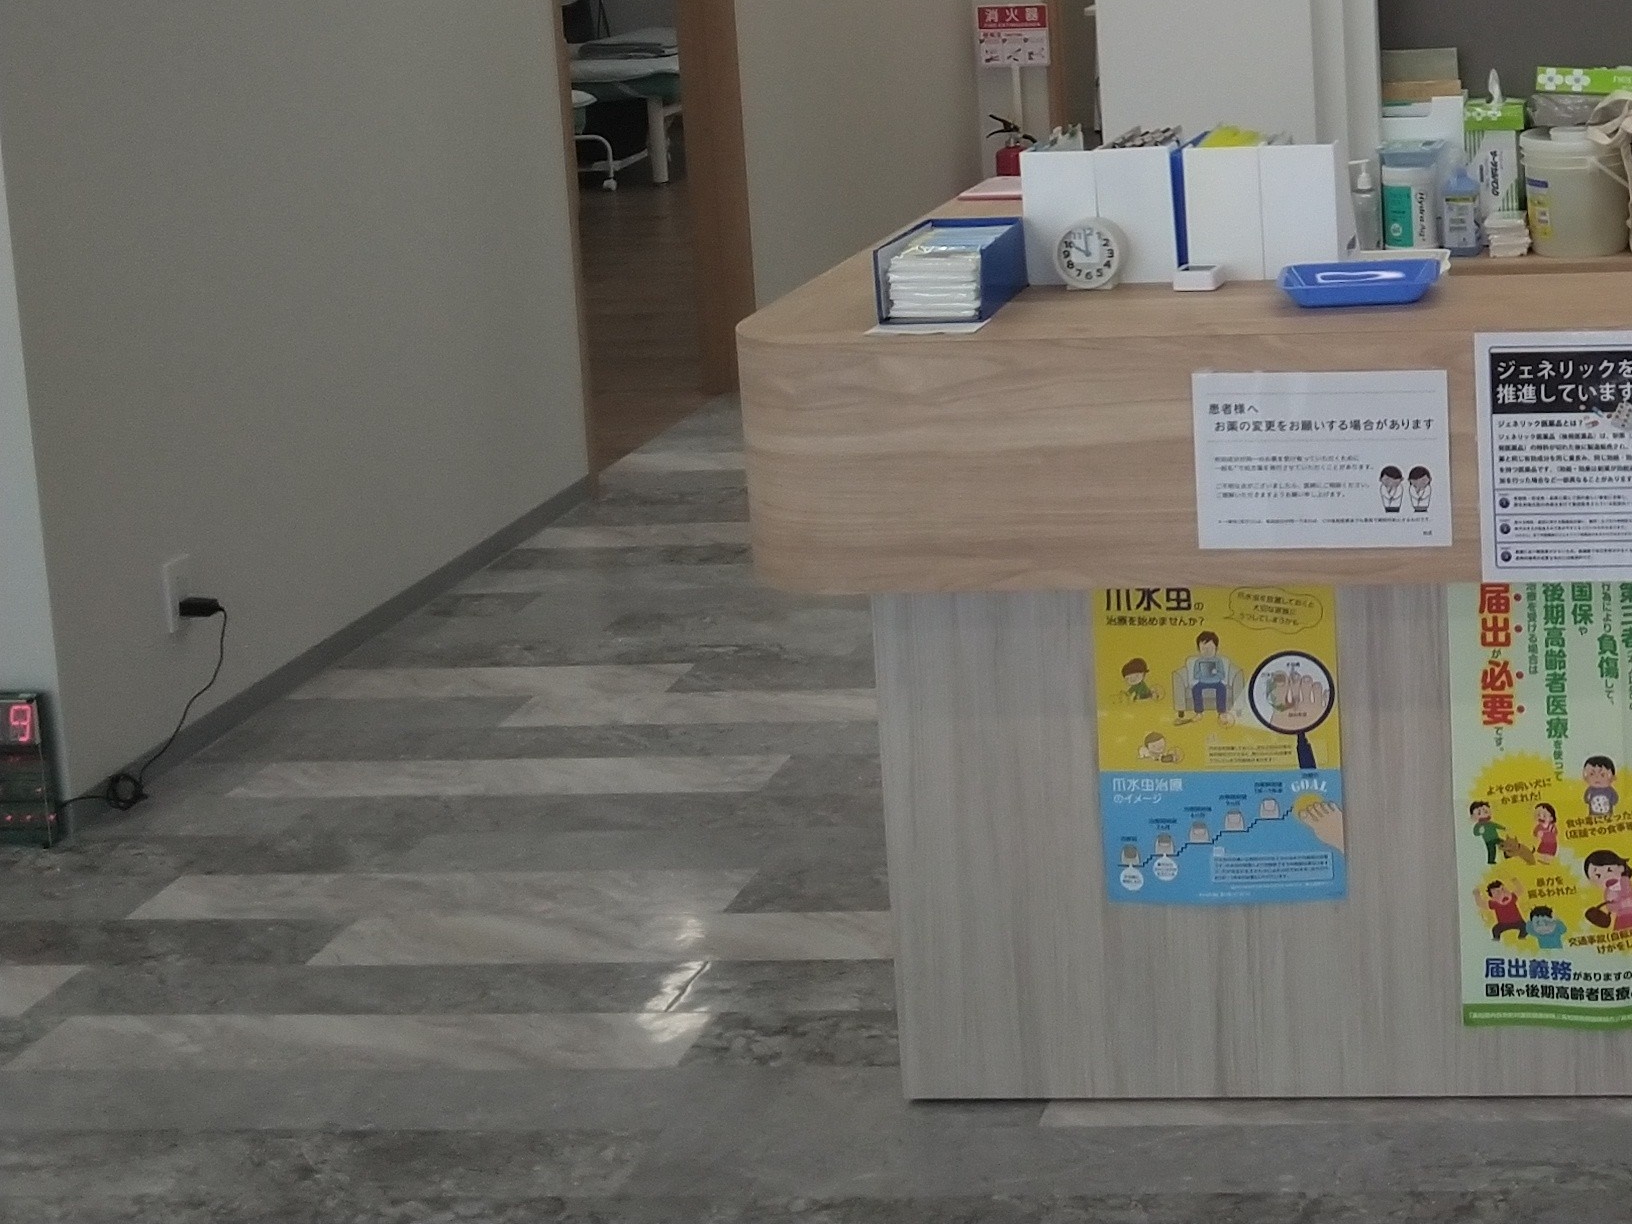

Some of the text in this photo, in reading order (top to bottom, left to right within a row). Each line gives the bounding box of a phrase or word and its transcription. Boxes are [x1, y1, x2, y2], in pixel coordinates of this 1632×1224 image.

[985, 7, 1038, 22] 消火器
[1102, 238, 1109, 247] 2
[1063, 250, 1070, 258] 9
[1107, 249, 1114, 258] 3
[1067, 260, 1074, 269] 8
[1103, 260, 1111, 268] 4
[1076, 268, 1082, 277] 7
[1085, 271, 1093, 280] 6
[1096, 268, 1103, 277] 5
[1209, 403, 1258, 415] 患者様へ
[1215, 418, 1434, 432] お薬の変更をお願いする場合があります
[1571, 582, 1593, 636] 国保や
[1479, 583, 1515, 752] 届出が必要です。
[1542, 582, 1569, 781] 後期高齢者医療を使って
[9, 705, 32, 742] 9
[1291, 778, 1328, 793] GOAL
[1487, 778, 1552, 796] よその飼い犬に
[1113, 793, 1162, 804] のイメージ
